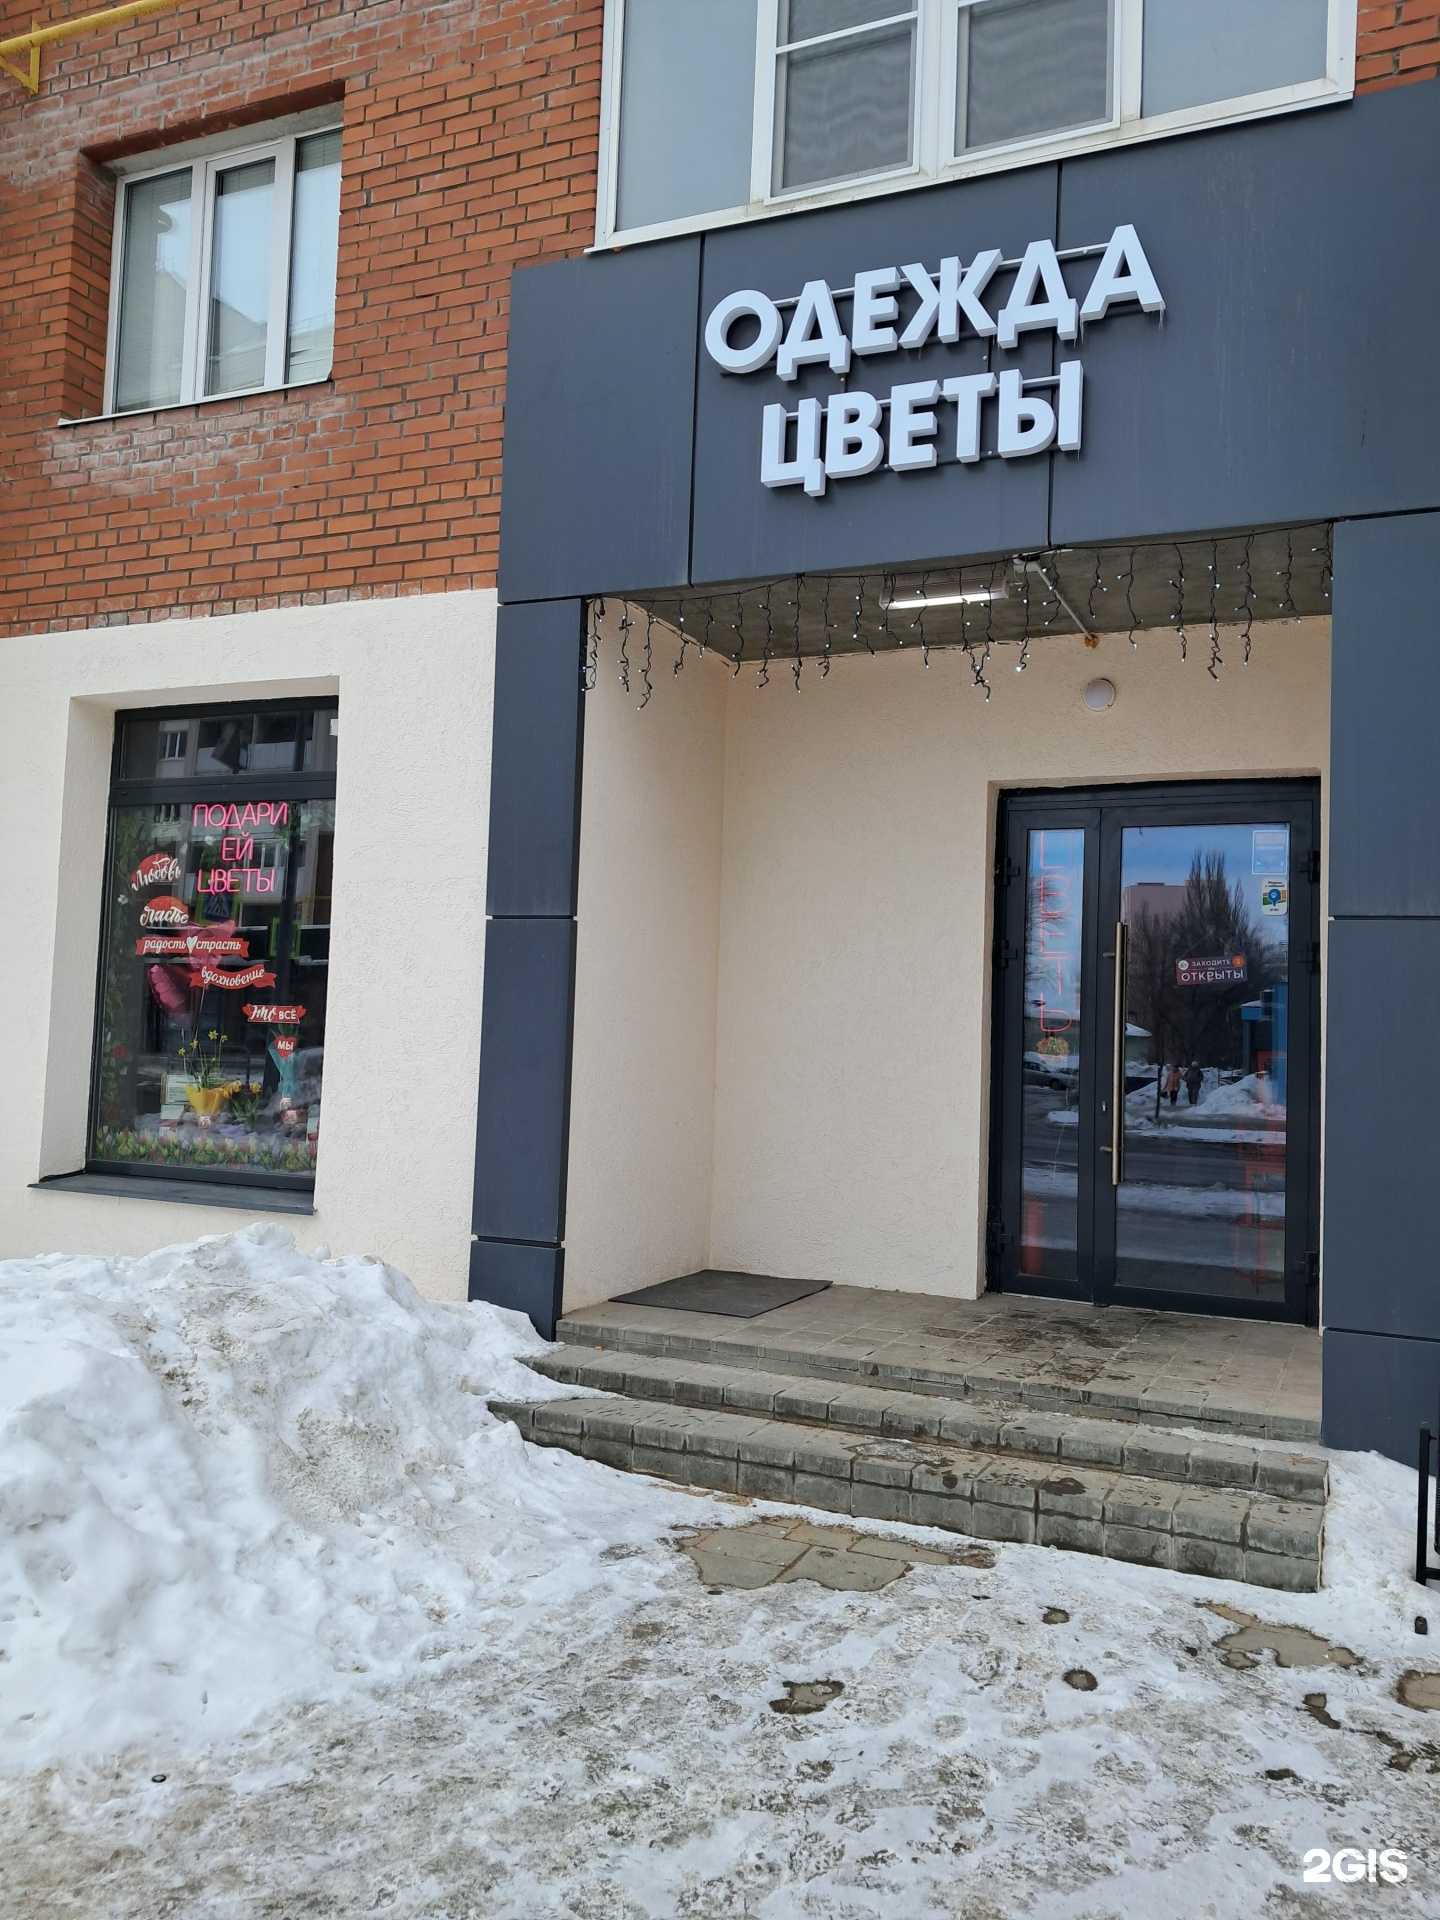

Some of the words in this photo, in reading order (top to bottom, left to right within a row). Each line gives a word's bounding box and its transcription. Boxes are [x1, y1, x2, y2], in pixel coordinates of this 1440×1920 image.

[704, 224, 1166, 381] ОДЕЖДА
[761, 360, 1083, 496] ЦВЕТЫ
[192, 801, 288, 829] ПОДАРИ
[221, 832, 254, 861] ЕЙ
[197, 868, 276, 895] ЦВЕТЫ
[143, 938, 187, 954] радость
[195, 939, 241, 952] страсть
[201, 966, 265, 986] вдохновение
[1181, 970, 1244, 982] ОТКРЫТЫ
